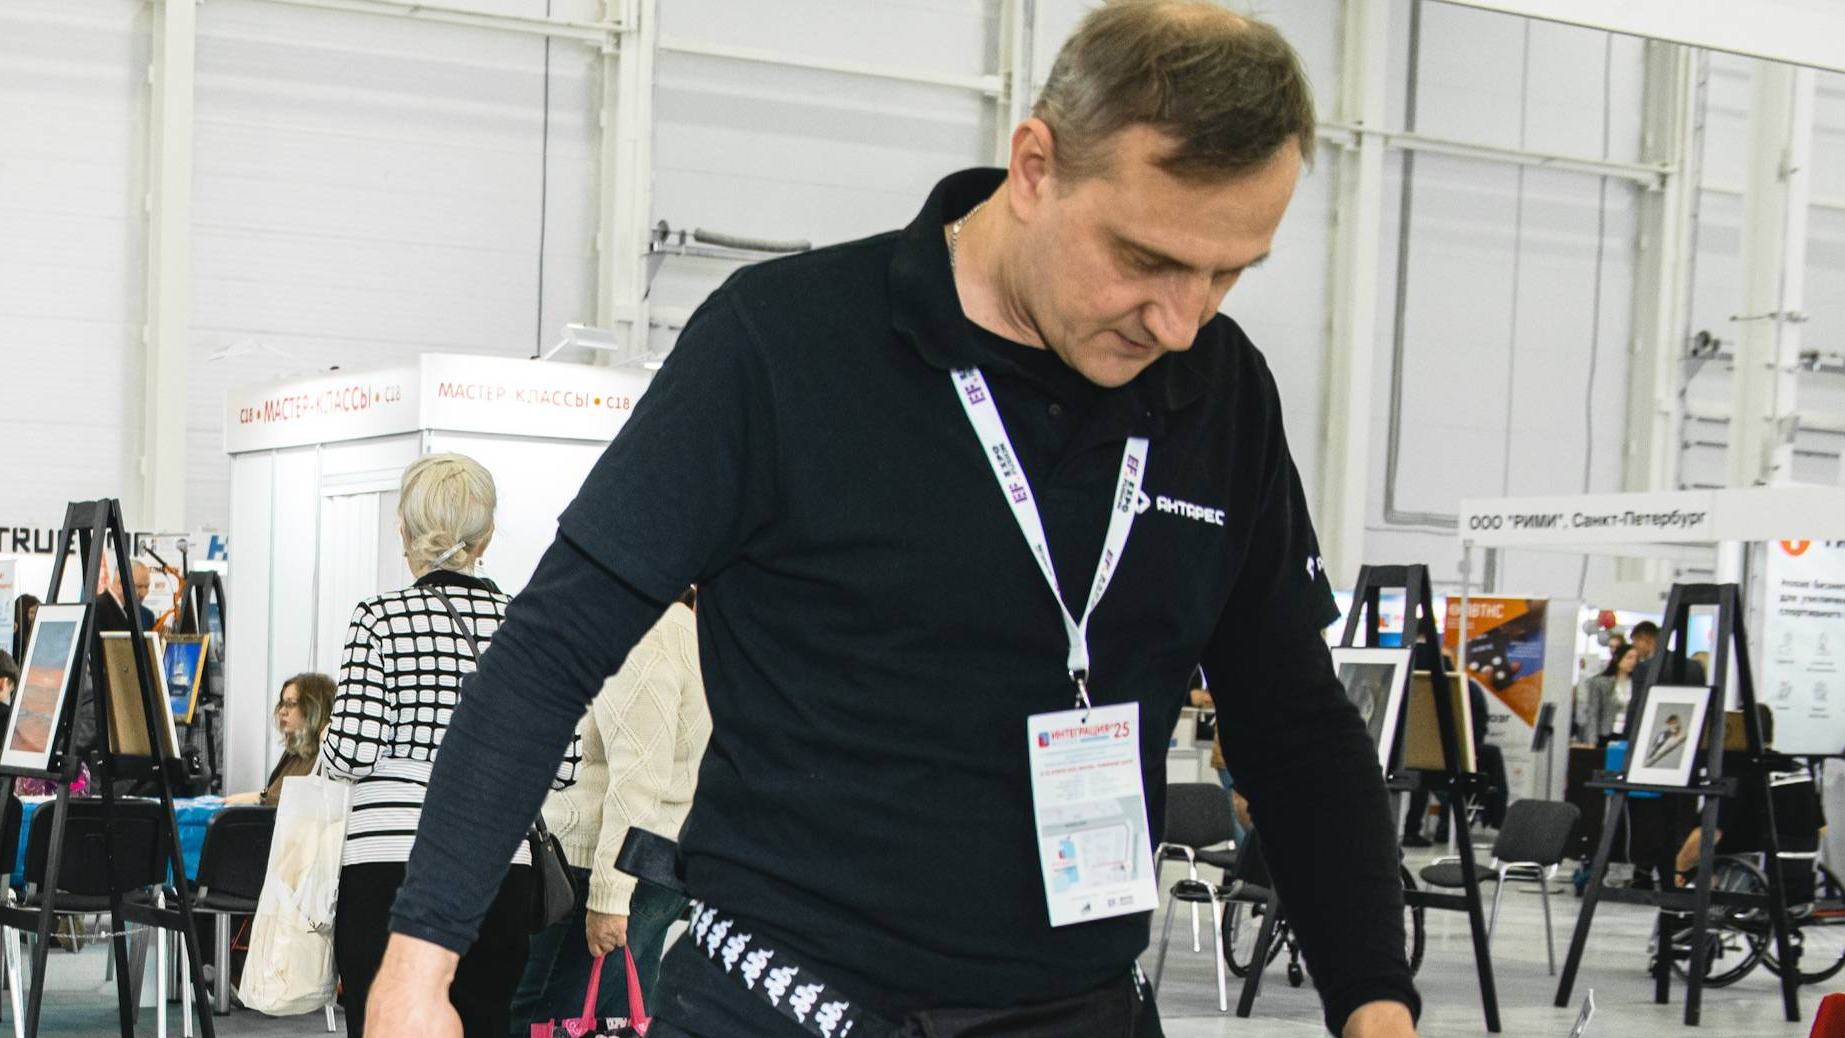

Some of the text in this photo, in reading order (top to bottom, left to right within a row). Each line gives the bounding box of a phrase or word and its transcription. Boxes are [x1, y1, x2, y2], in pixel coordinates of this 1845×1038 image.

[263, 384, 371, 424] МАСТЕР-КЛАССЫ
[1156, 495, 1225, 527] АНТАРЕС
[1470, 509, 1707, 531] ООО "РИМИ", Санкт-Петербург
